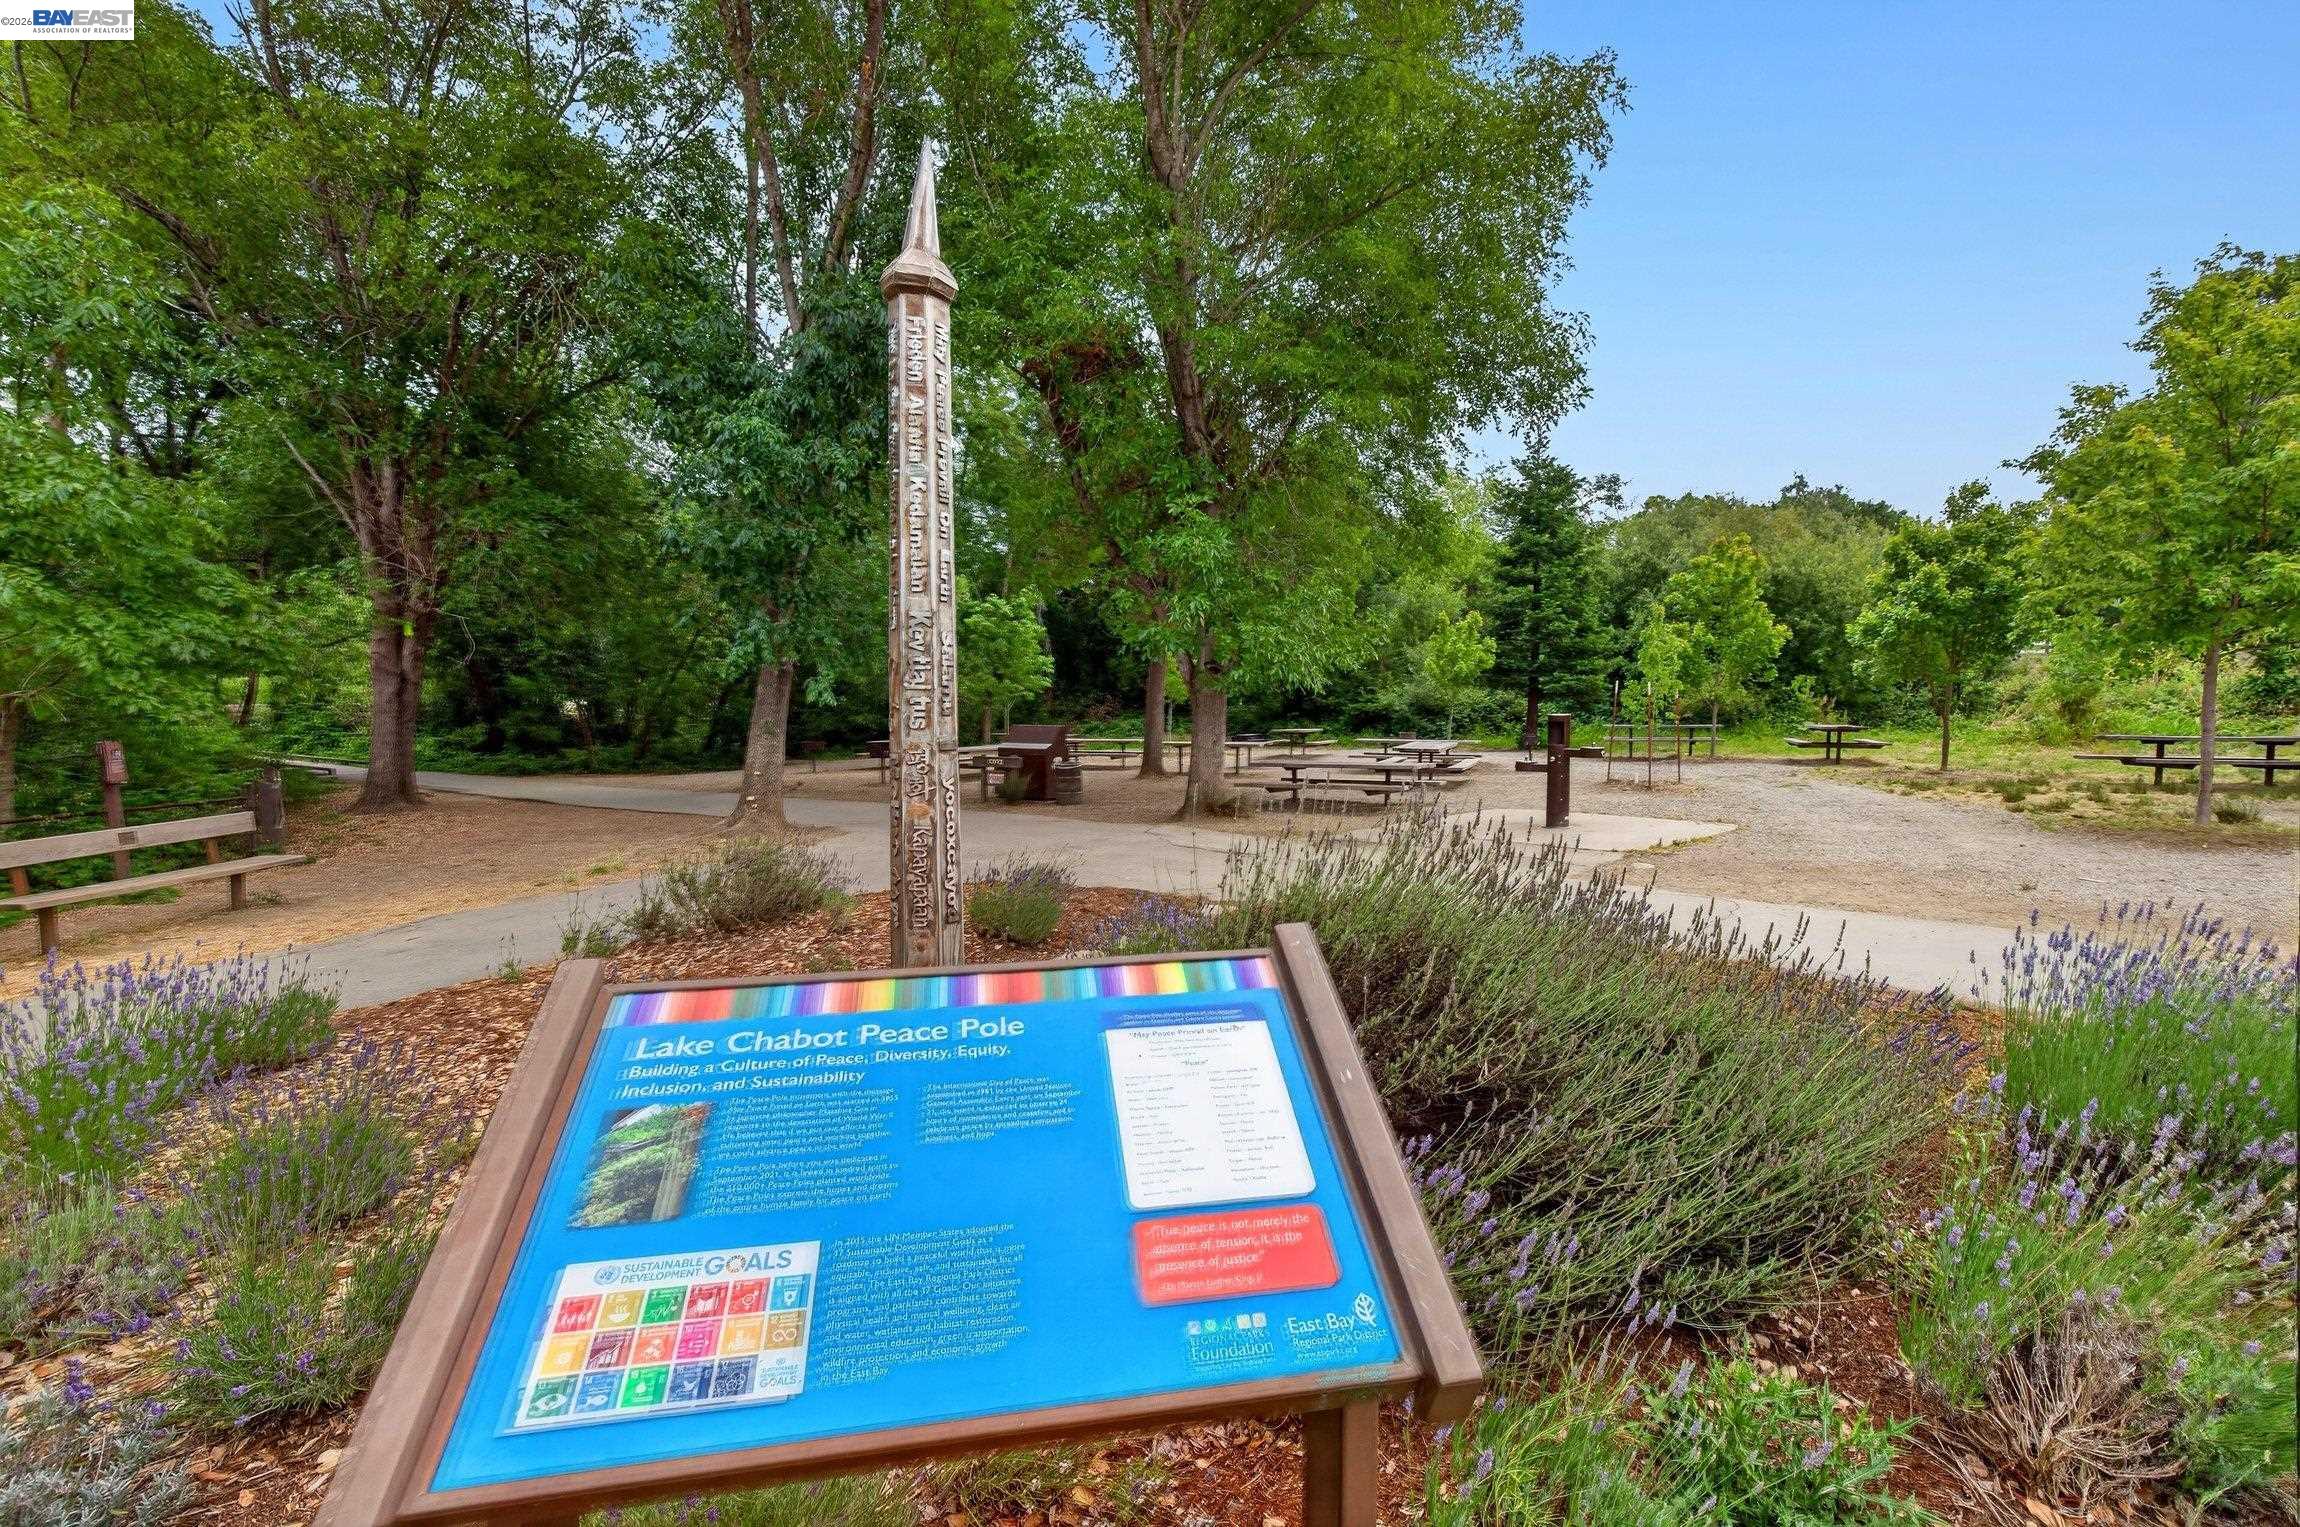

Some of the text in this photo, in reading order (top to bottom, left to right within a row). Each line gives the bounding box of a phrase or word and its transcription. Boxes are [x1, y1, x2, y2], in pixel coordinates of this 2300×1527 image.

[906, 316, 926, 382] Frieden
[934, 321, 950, 363] May
[935, 369, 950, 432] Peace
[936, 436, 950, 505] Prevail
[939, 550, 952, 603] Earth
[634, 1015, 1024, 1060] Lake Chabot Peace Pole
[626, 1061, 700, 1080] Building
[719, 1055, 787, 1072] Culture
[792, 1054, 812, 1067] of
[816, 1050, 869, 1065] Peace,
[875, 1045, 951, 1064] Diversity,
[621, 1068, 864, 1098] Inclusion, and Sustainability
[1230, 1217, 1250, 1231] not
[1252, 1213, 1290, 1229] merely
[1291, 1211, 1310, 1225] the
[619, 1267, 702, 1284] DEVELOPMENT
[622, 1257, 704, 1273] SUSTAINABLE
[703, 1249, 792, 1276] GOALS
[1286, 1310, 1360, 1333] East Bay
[1191, 1338, 1274, 1361] Foundation
